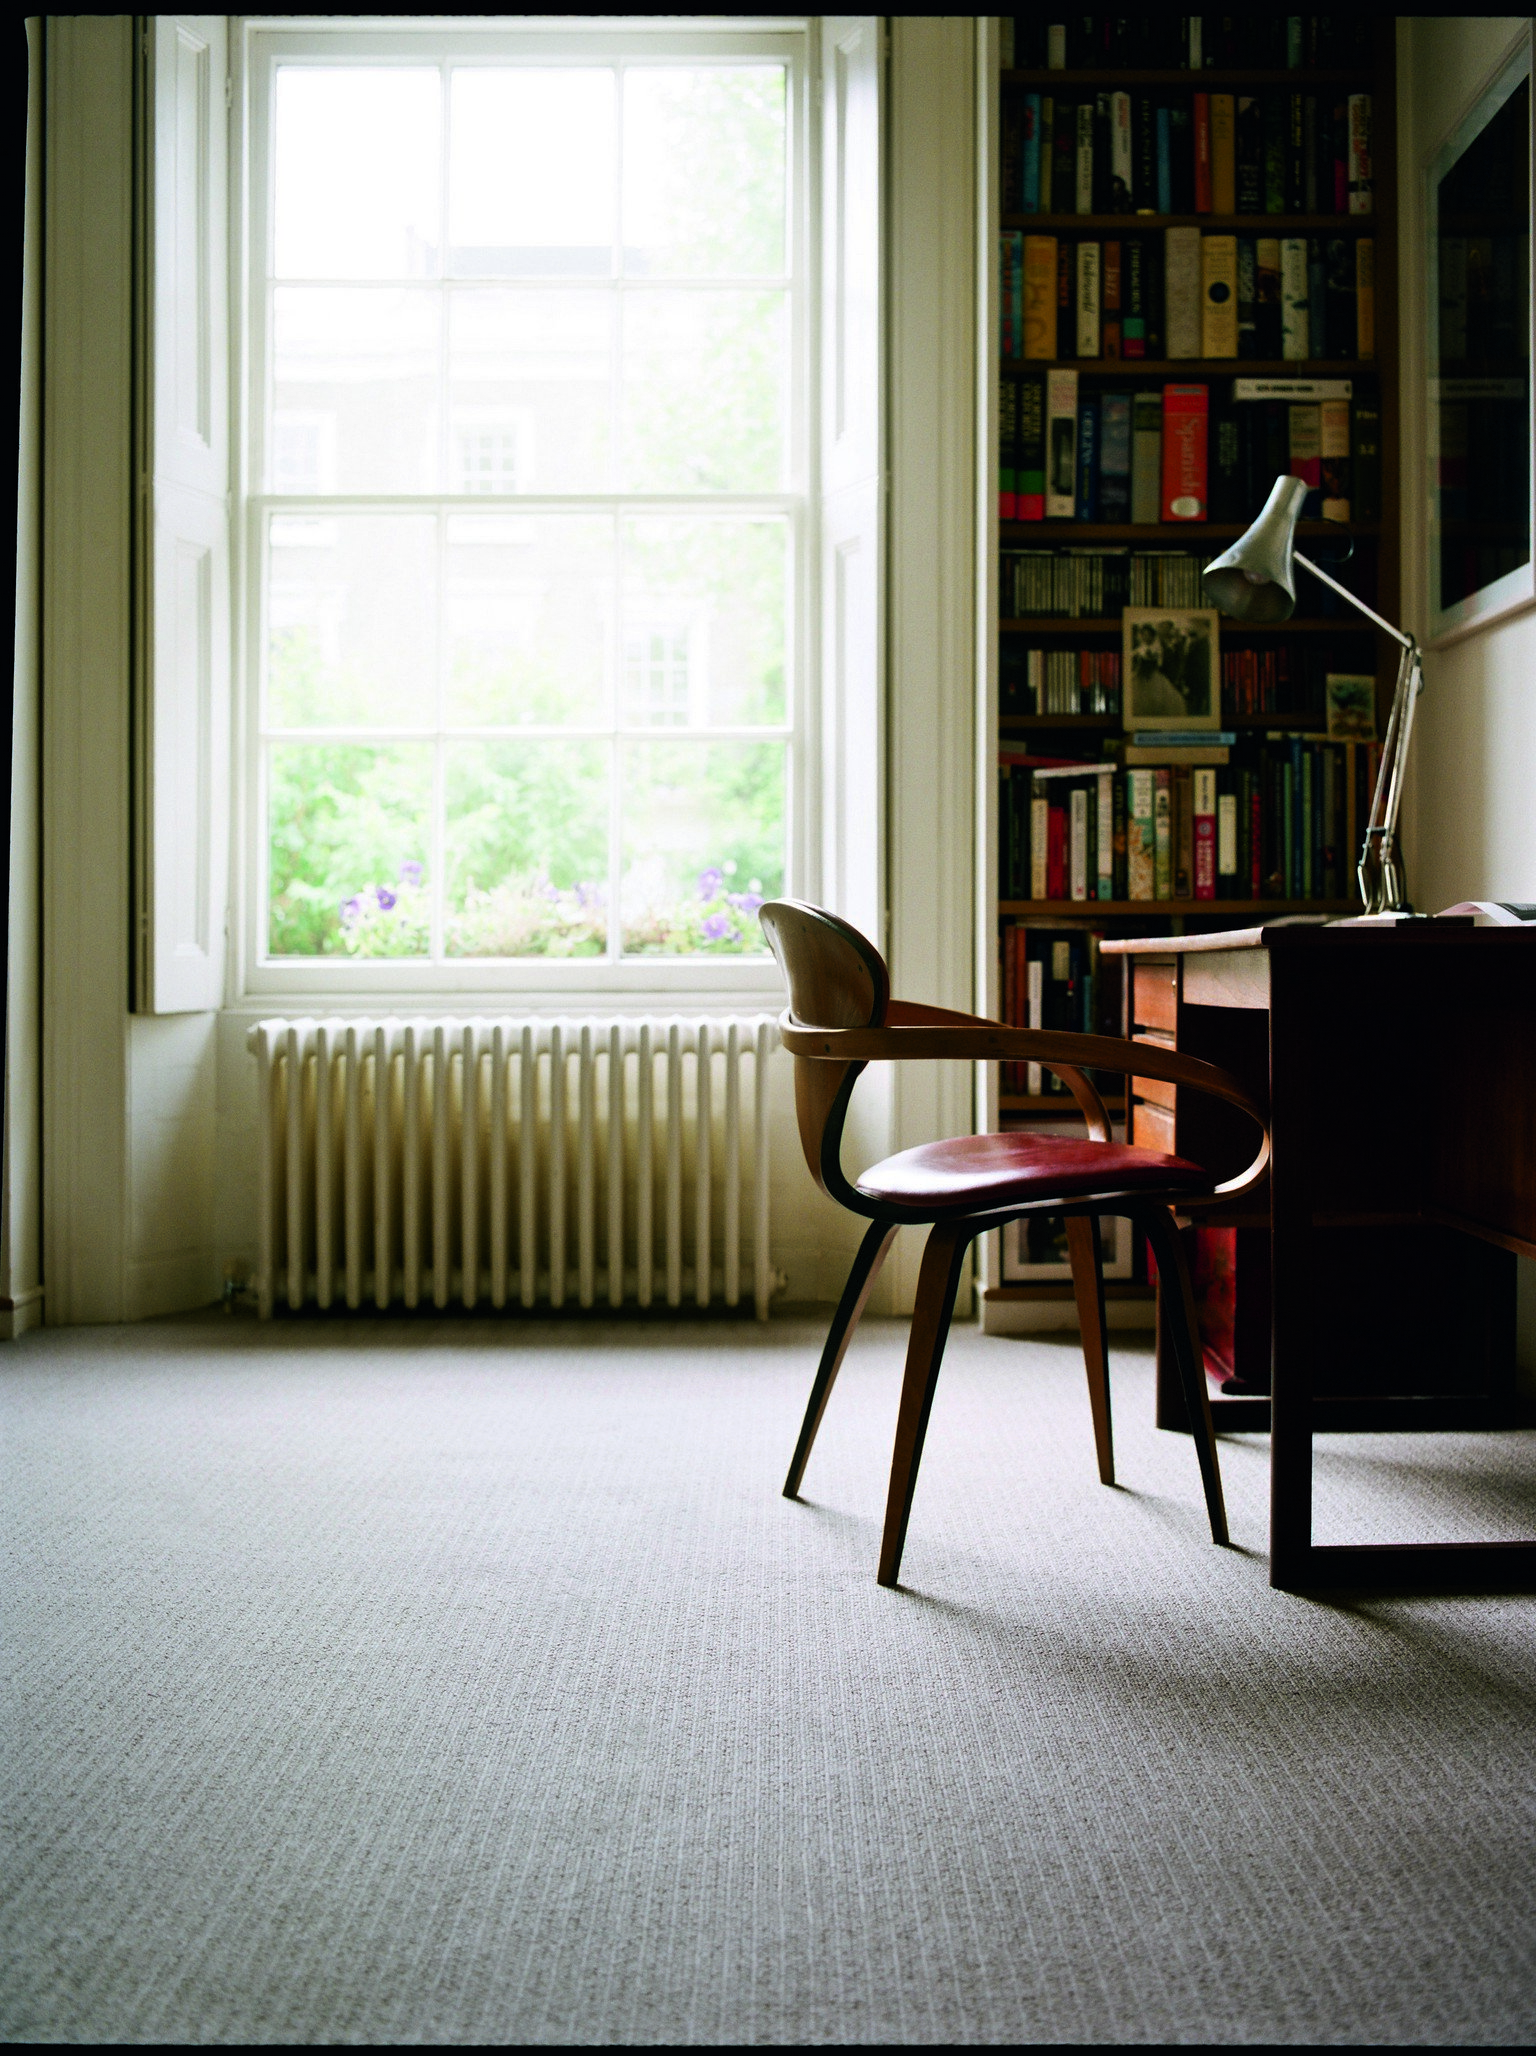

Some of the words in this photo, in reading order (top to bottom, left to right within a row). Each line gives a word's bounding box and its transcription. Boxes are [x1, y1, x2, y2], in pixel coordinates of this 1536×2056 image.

[1082, 251, 1096, 315] Underworld
[1104, 266, 1121, 297] Jazz
[1175, 418, 1201, 496] Spanish
